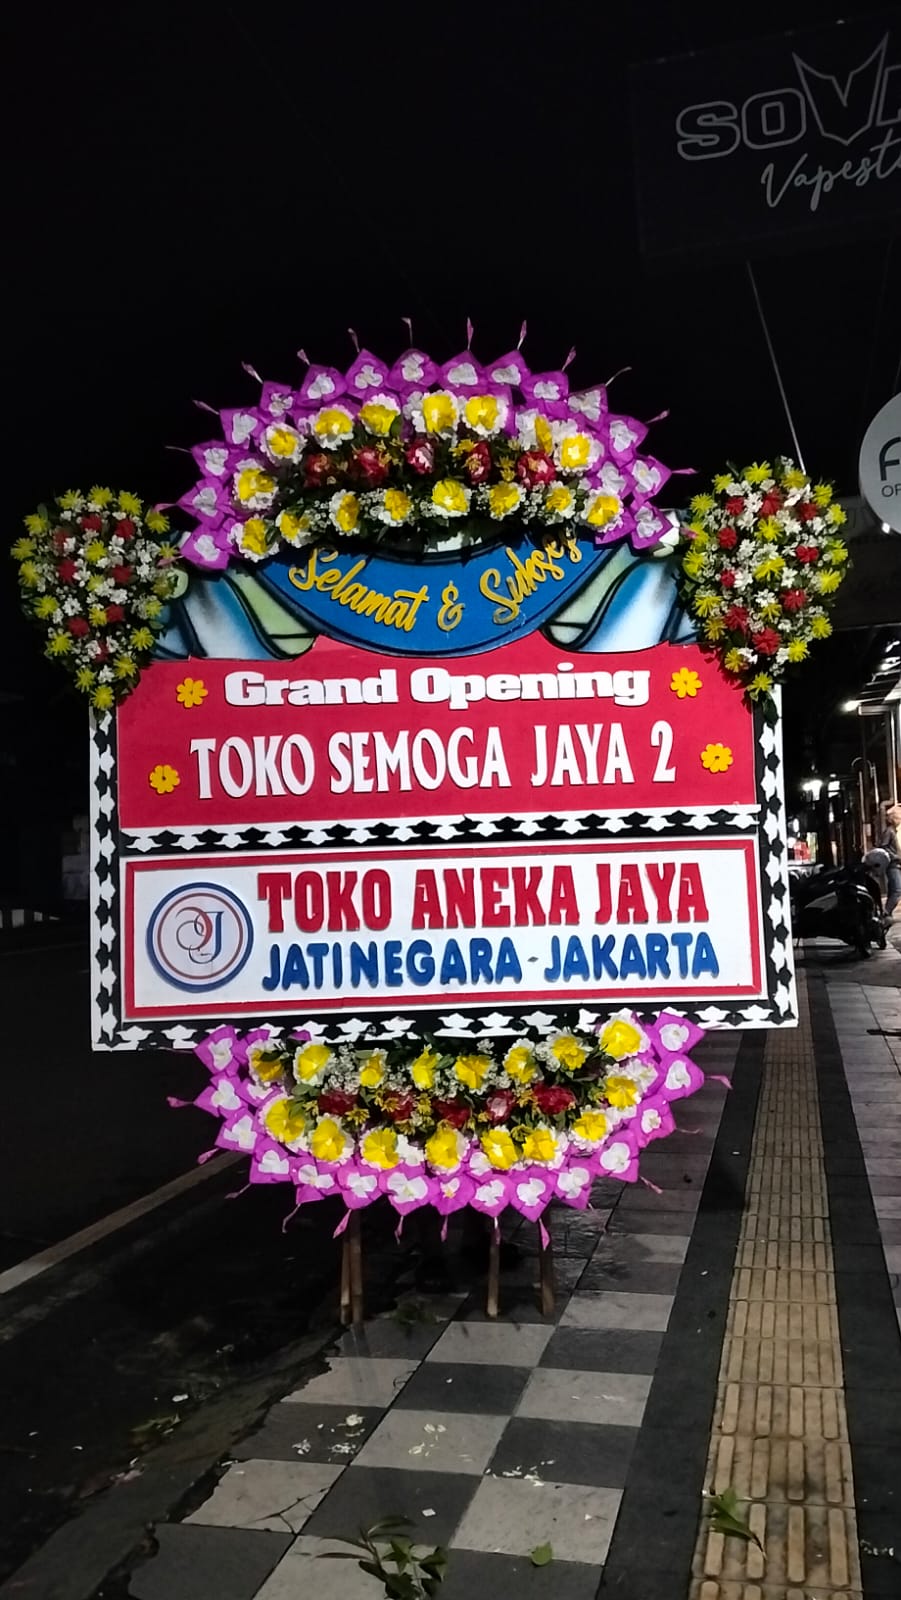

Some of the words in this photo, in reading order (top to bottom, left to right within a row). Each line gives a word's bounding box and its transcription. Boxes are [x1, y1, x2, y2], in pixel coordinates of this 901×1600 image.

[761, 128, 901, 211] Vapest
[288, 547, 429, 632] Selamat
[437, 581, 465, 632] &
[479, 536, 583, 625] Sukses
[224, 668, 398, 706] Grand
[410, 662, 651, 710] Opening
[189, 733, 315, 799] TOKO
[327, 726, 512, 794] SEMOGA
[530, 722, 635, 787] JAYA
[650, 720, 676, 782] 2
[257, 866, 392, 934] TOKO
[411, 864, 580, 929] ANEKA
[594, 862, 709, 925] JAYA
[262, 936, 522, 992] JATINEGARA
[544, 932, 720, 983] JAKARTA
